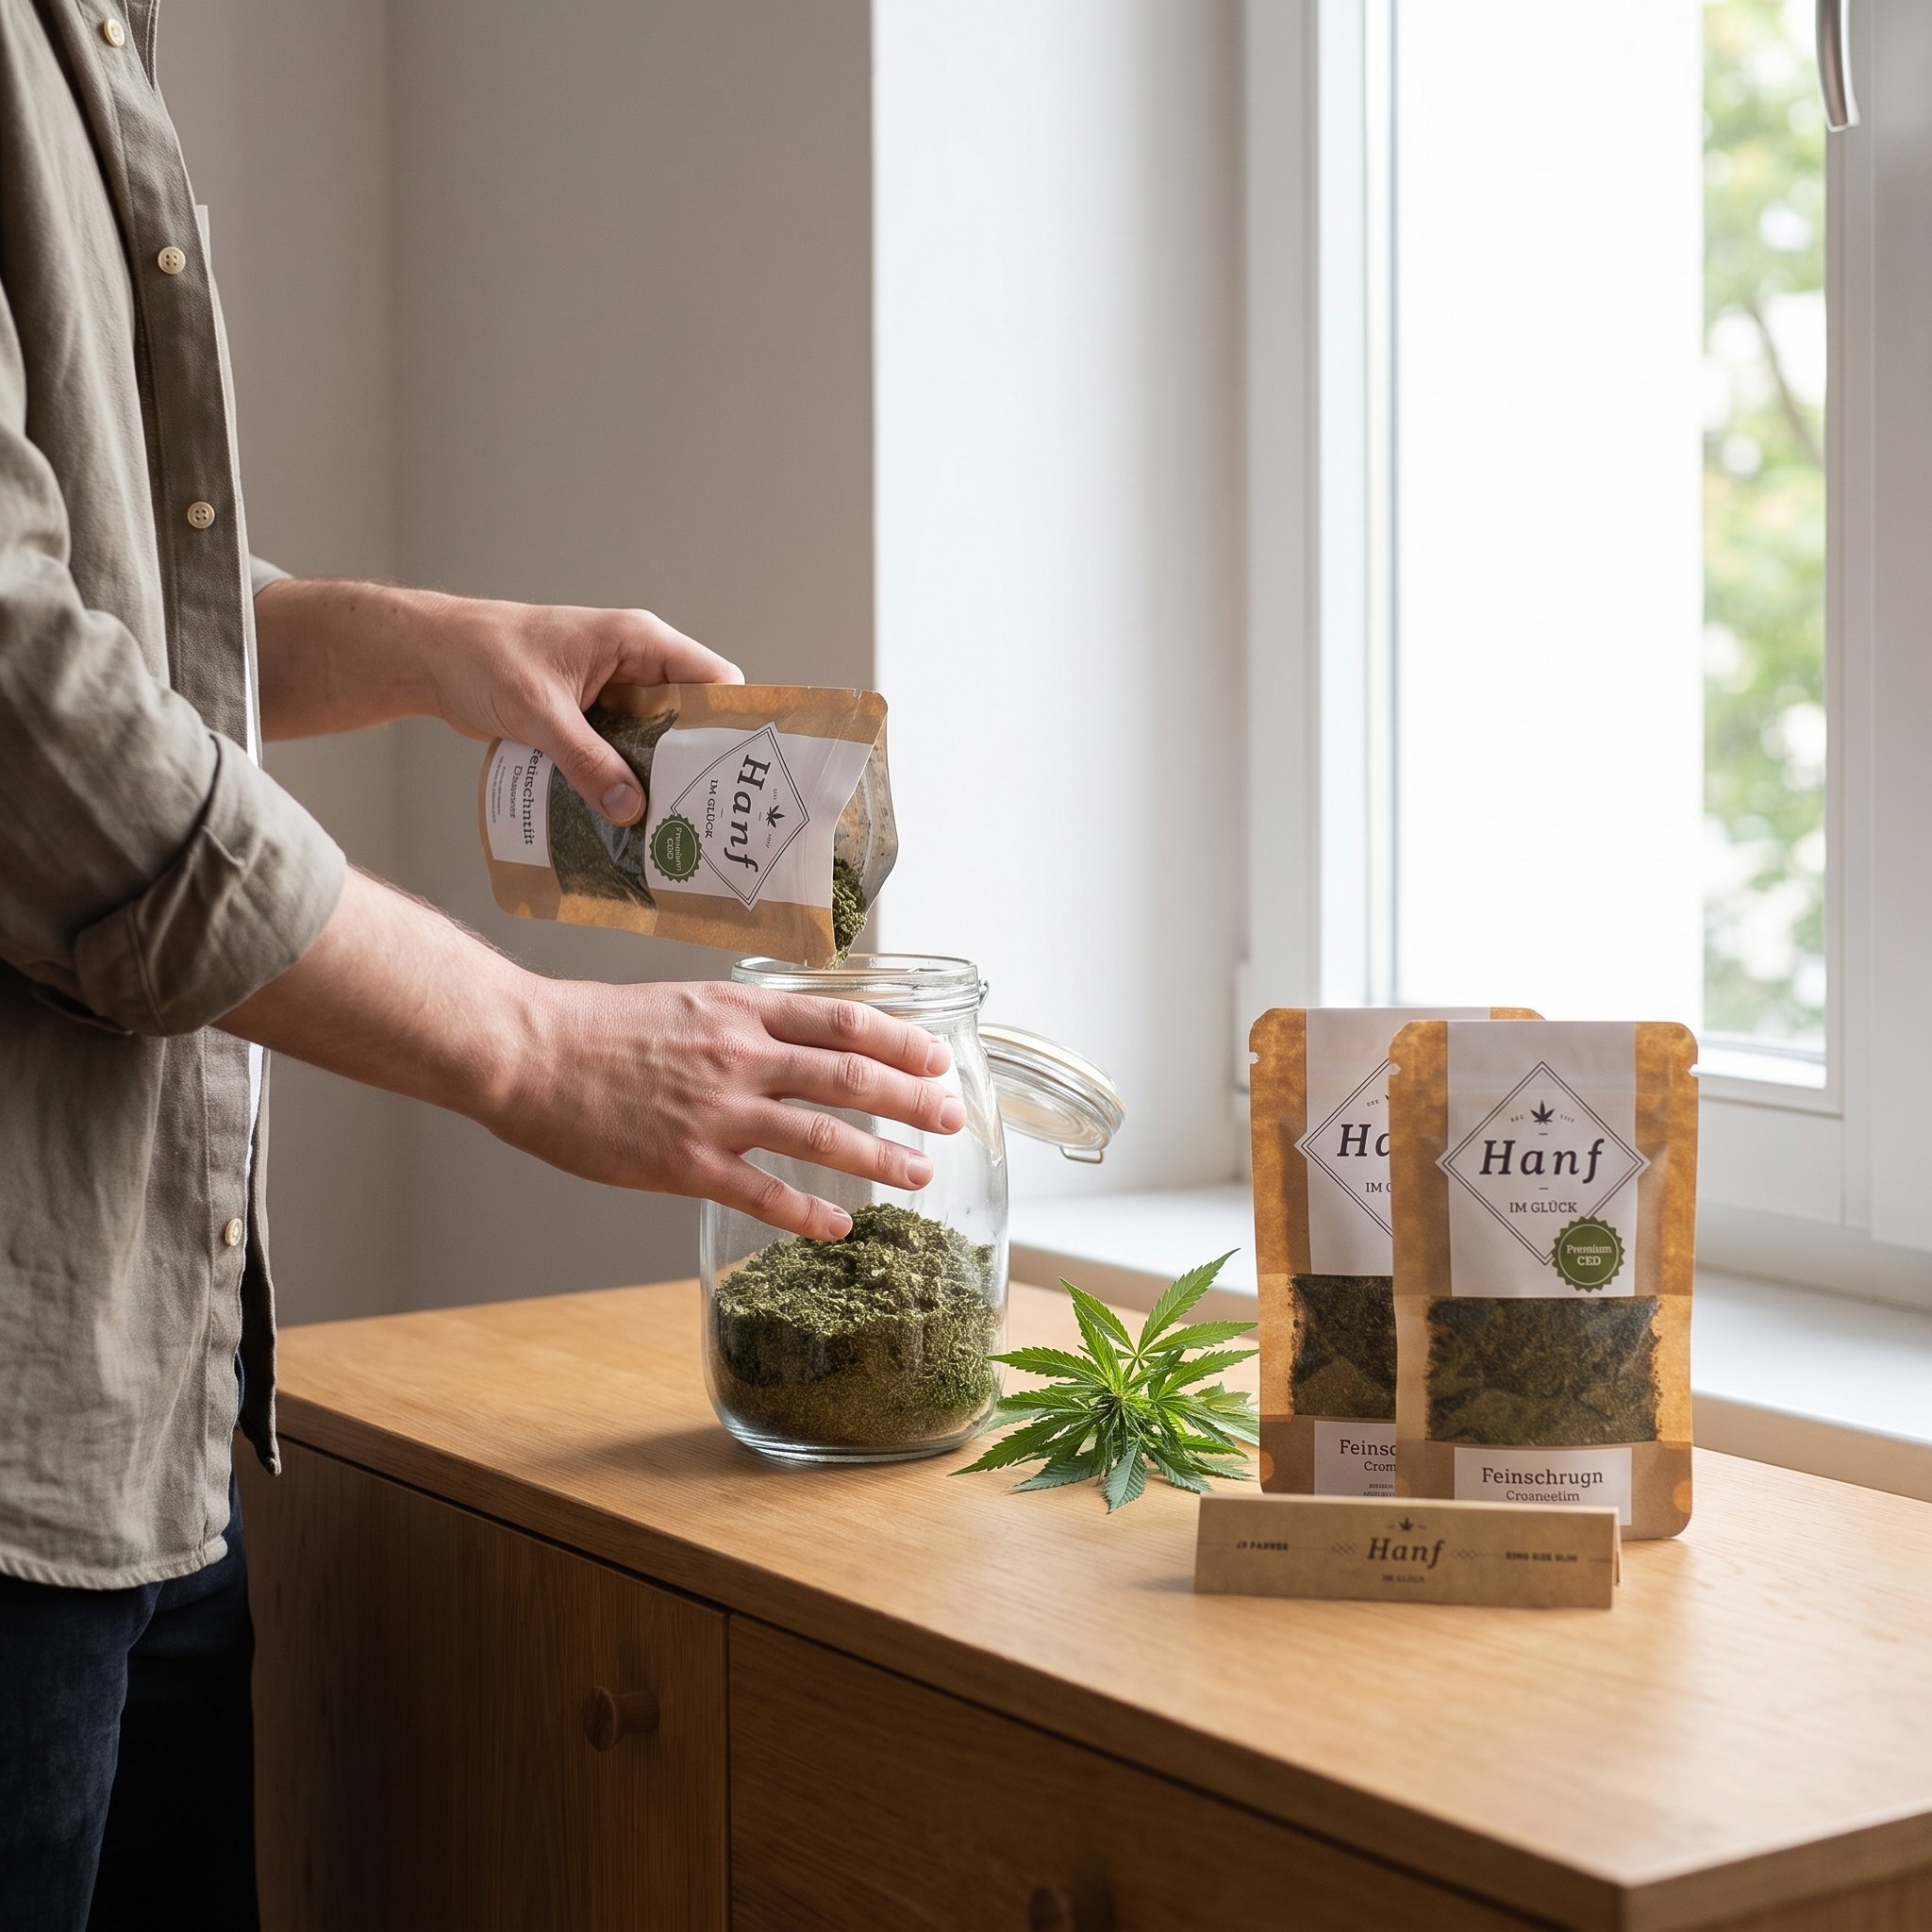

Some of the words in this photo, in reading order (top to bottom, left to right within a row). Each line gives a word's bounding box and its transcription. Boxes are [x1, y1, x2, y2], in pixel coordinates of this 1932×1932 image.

[724, 754, 772, 873] Hanf
[1479, 1138, 1605, 1184] Hanf
[1366, 1182, 1383, 1192] IM
[1509, 1202, 1527, 1213] IM
[1530, 1199, 1577, 1213] GLÜCK
[1481, 1467, 1604, 1488] Feinschrugn
[1368, 1537, 1445, 1570] Hanf
